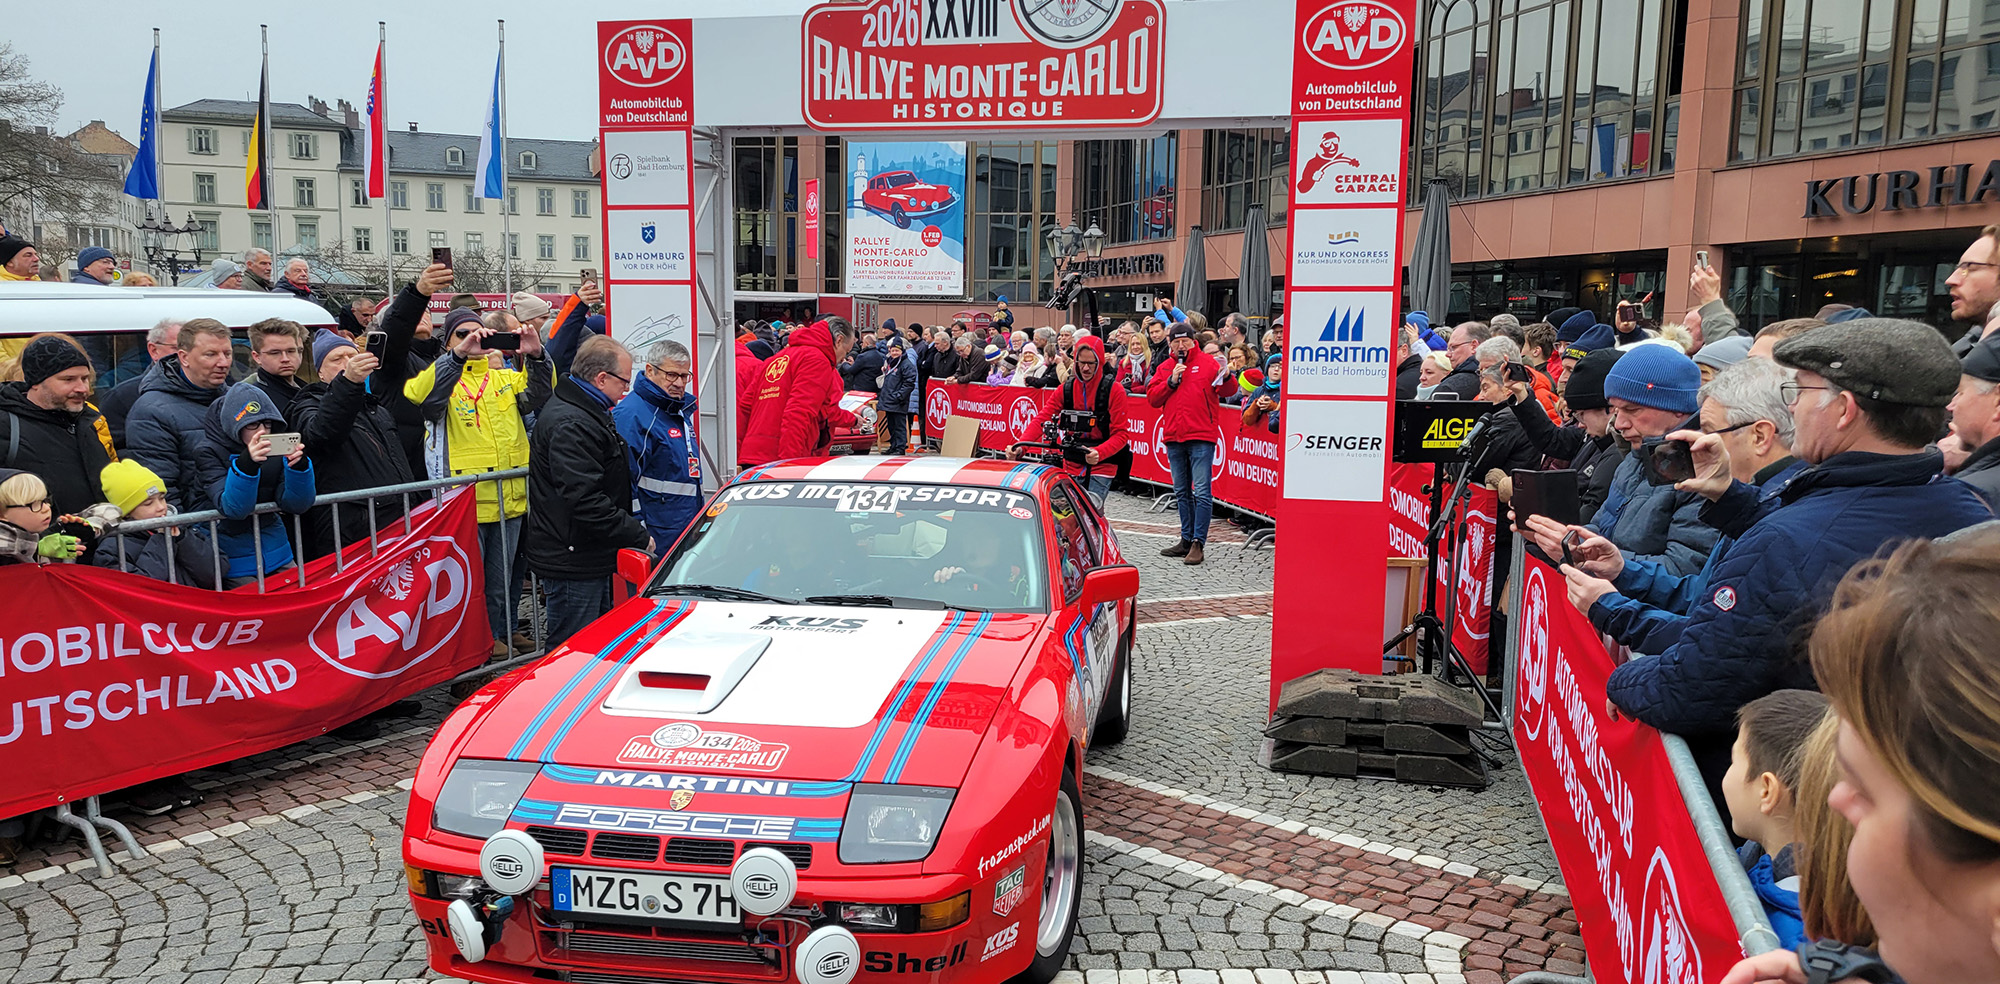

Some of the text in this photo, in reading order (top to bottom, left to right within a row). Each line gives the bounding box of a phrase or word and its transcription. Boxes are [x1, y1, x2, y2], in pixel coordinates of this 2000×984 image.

[1333, 10, 1341, 18] 18
[862, 0, 998, 47] 2026 XXVIII
[813, 27, 1149, 100] RALLYE MONTE-CARLO
[1305, 80, 1397, 95] Automobilclub
[610, 97, 682, 109] Automobilclub
[893, 101, 1063, 118] HISTORIQUE
[1299, 96, 1402, 110] von Deutschland
[606, 110, 688, 122] von Deutschland
[1335, 174, 1397, 184] CENTRAL
[1334, 184, 1396, 194] GARAGE
[854, 237, 890, 246] RALLYE
[854, 248, 928, 256] MONTE-CARLO
[656, 262, 676, 270] HÖHE
[854, 259, 914, 267] HISTORIQUE
[1292, 346, 1388, 363] MARITIM
[1293, 366, 1387, 378] Hotel Bad Homburg
[957, 400, 1003, 415] AUTOMOBILCLUB
[980, 420, 1006, 433] SCHLAND
[1305, 435, 1382, 451] SENGER
[1228, 460, 1245, 479] VON
[725, 484, 1024, 509] KÜS MORSPORT
[846, 491, 894, 511] 134
[1389, 486, 1431, 530] OMOBILC
[414, 547, 431, 562] 99
[336, 556, 465, 659] AvD
[750, 625, 857, 634] MOTORSPORT
[759, 615, 869, 630] KÜS
[702, 736, 733, 748] 134
[733, 738, 761, 752] 2026
[623, 741, 784, 766] RALLYE MONTE-CARLO
[1555, 647, 1633, 859] AUTOMOBILCLUB
[658, 760, 736, 768] HISTORIQUE
[594, 771, 789, 795] MARTINI
[554, 806, 795, 841] PORSCHE
[978, 814, 1051, 878] frozenspeed.com
[492, 861, 523, 873] HELLA
[746, 882, 778, 891] HELLA
[999, 870, 1022, 894] TAG
[559, 894, 566, 902] D
[573, 874, 639, 910] MZG
[664, 882, 683, 913] S
[995, 886, 1021, 913] HEUER
[820, 956, 850, 972] HELLA
[865, 941, 968, 973] Shell
